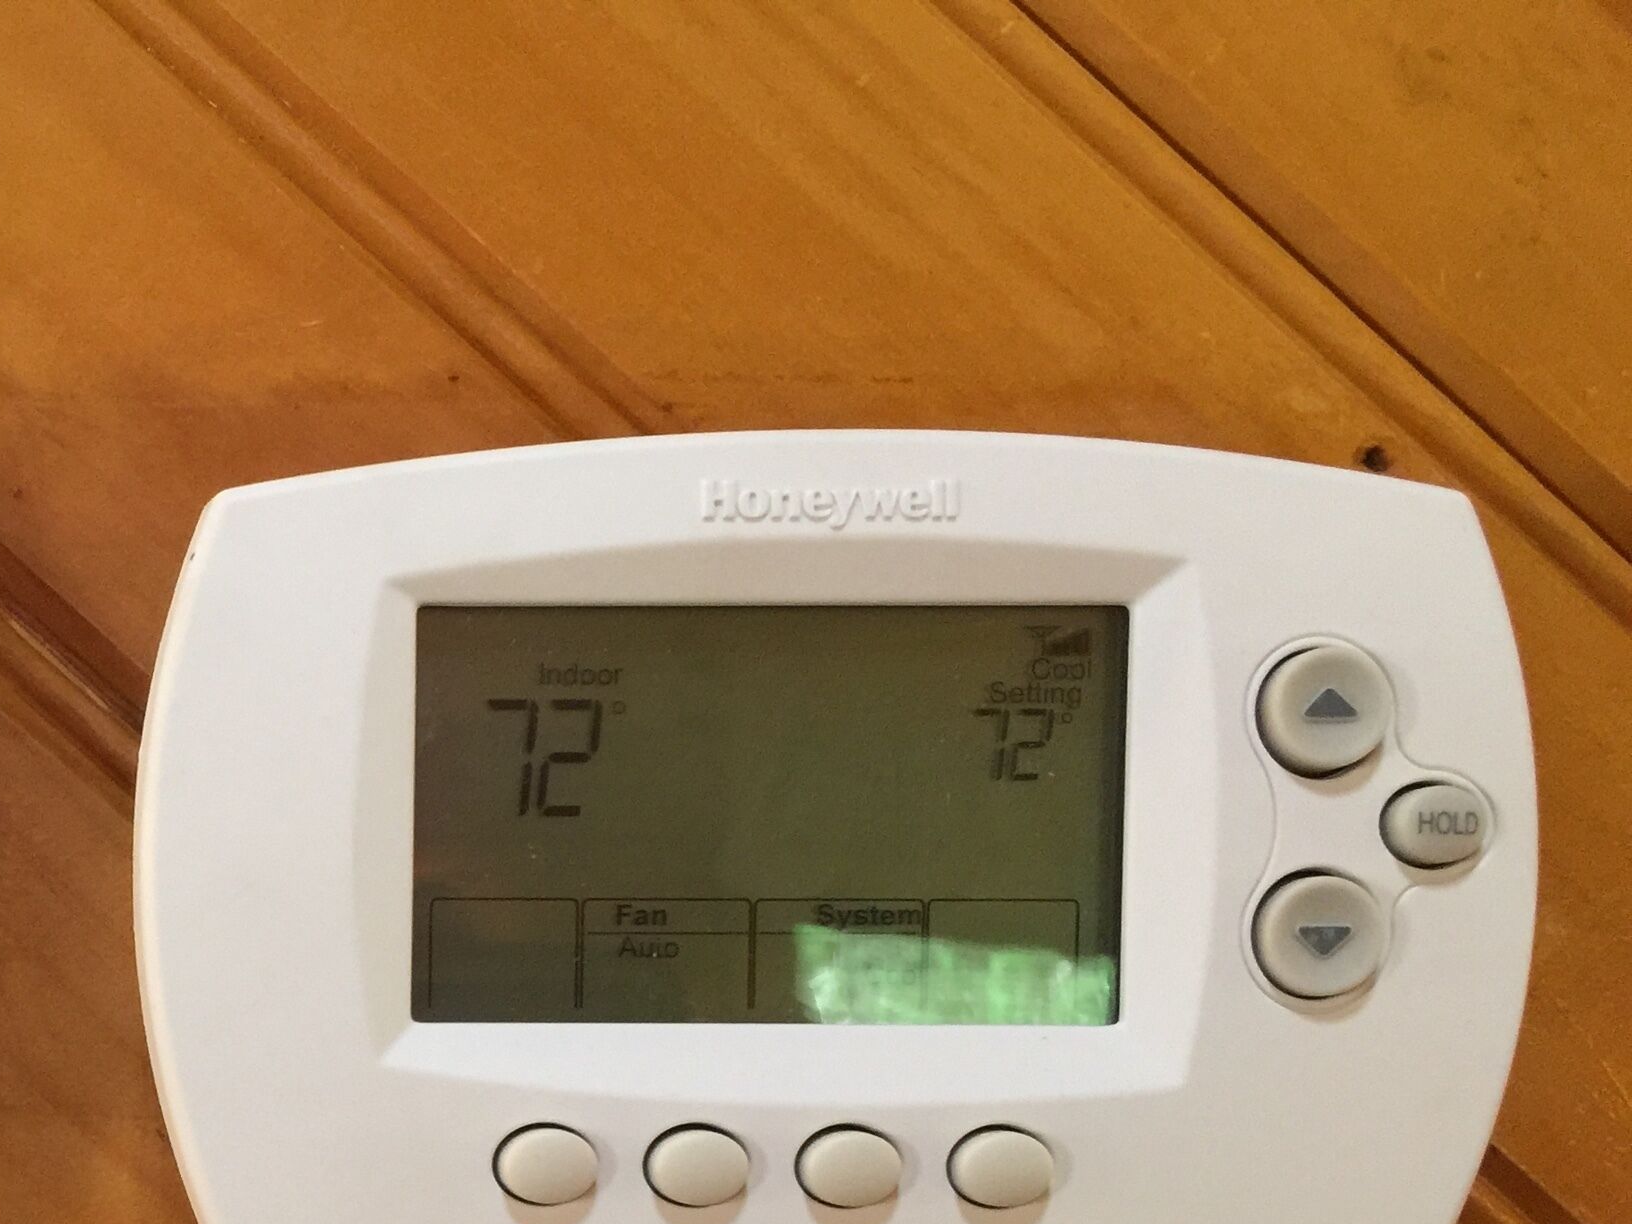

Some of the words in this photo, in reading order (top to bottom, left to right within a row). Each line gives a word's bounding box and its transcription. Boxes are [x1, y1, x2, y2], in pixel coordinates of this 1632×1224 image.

[703, 479, 960, 531] Honeywell
[537, 662, 623, 686] Indoor
[1032, 657, 1092, 681] Cool
[990, 681, 1082, 710] Setting
[1418, 811, 1479, 835] HOLD
[616, 904, 668, 926] Fan
[816, 903, 922, 929] System
